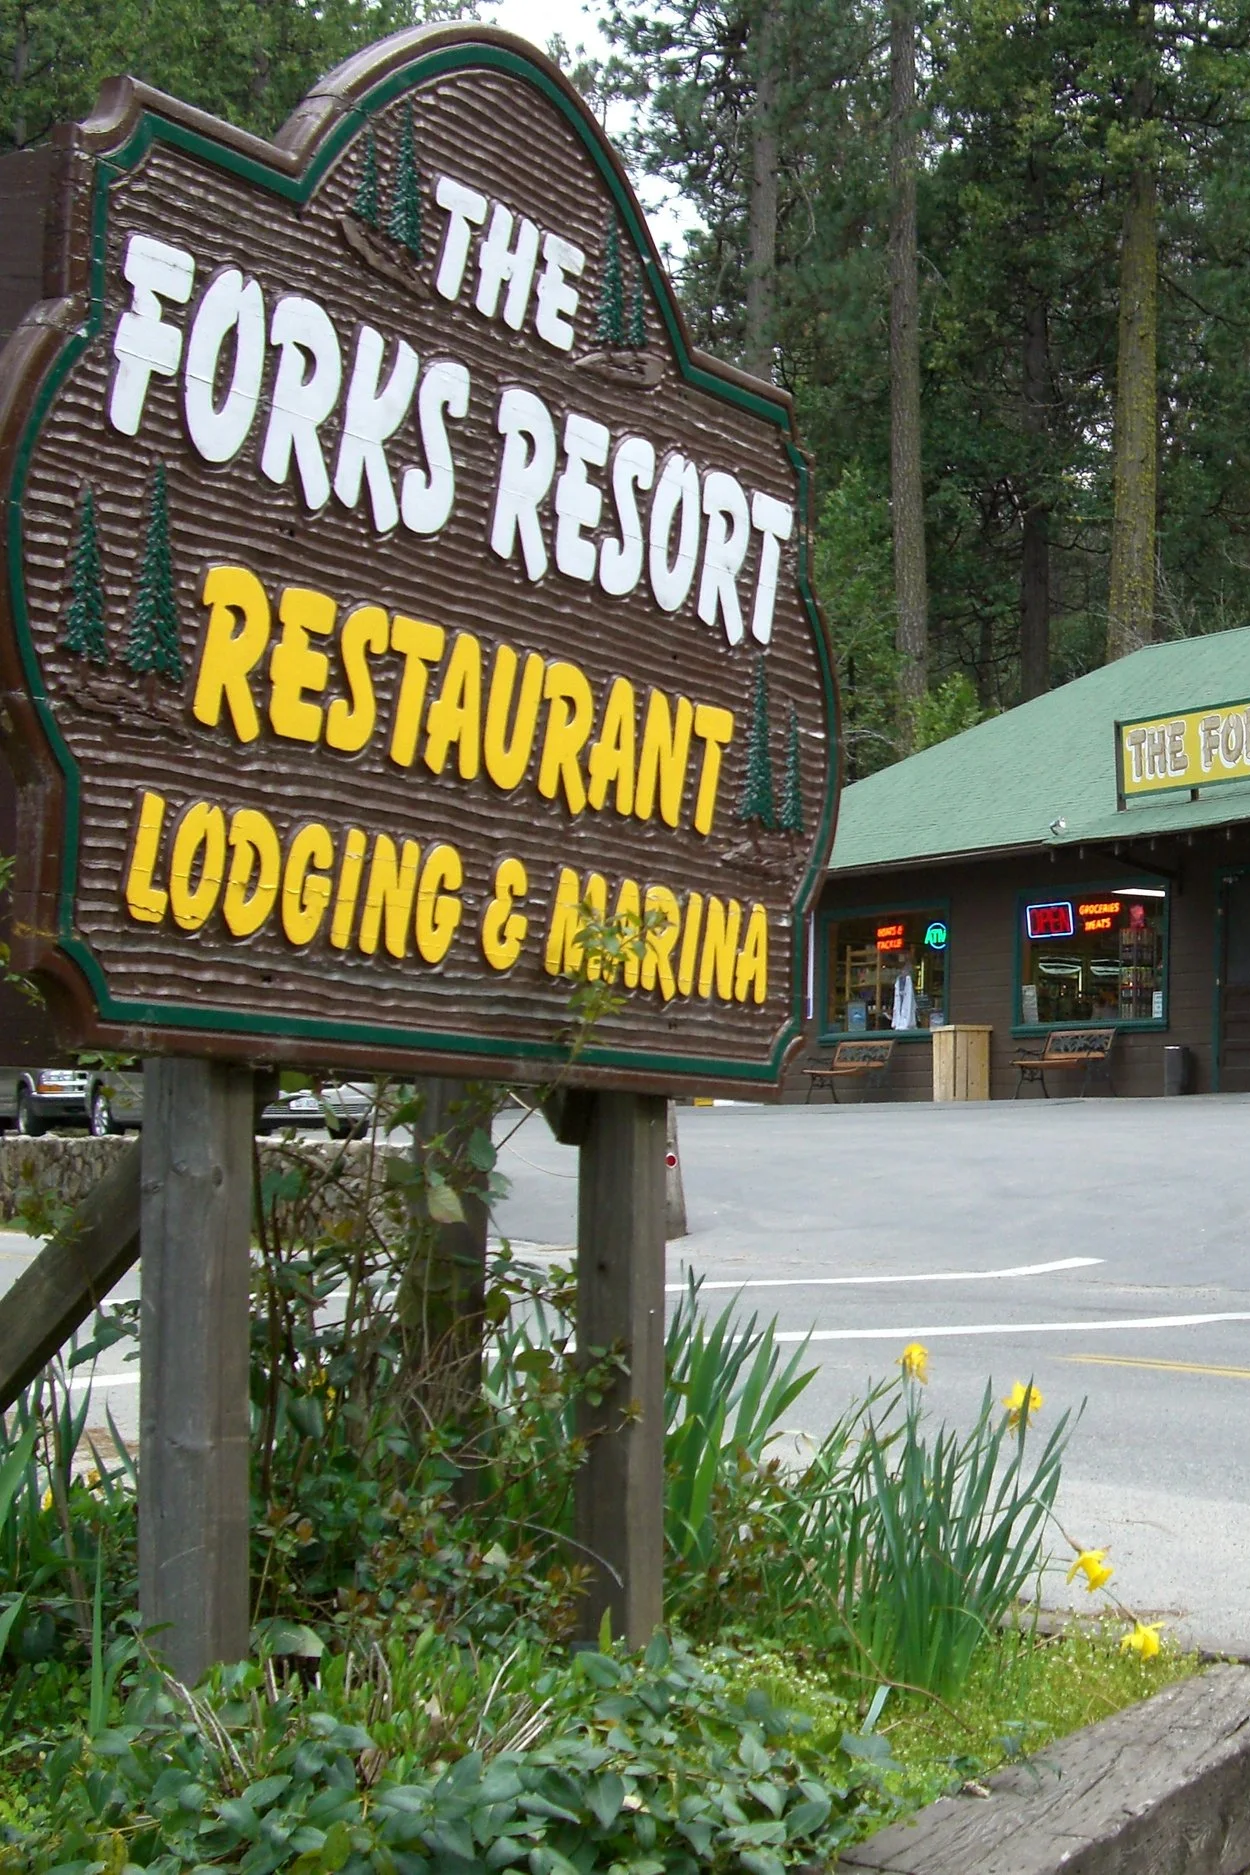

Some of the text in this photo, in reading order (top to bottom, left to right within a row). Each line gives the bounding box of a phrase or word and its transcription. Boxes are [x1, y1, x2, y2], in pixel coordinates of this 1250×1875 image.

[434, 174, 586, 352] THE
[109, 233, 795, 647] FORKS RESORT
[192, 566, 735, 837] RESTAURANT
[1128, 720, 1189, 782] THE
[126, 792, 769, 1005] LODGING & MARINA
[924, 928, 947, 944] ATM
[1030, 906, 1071, 935] OPEN
